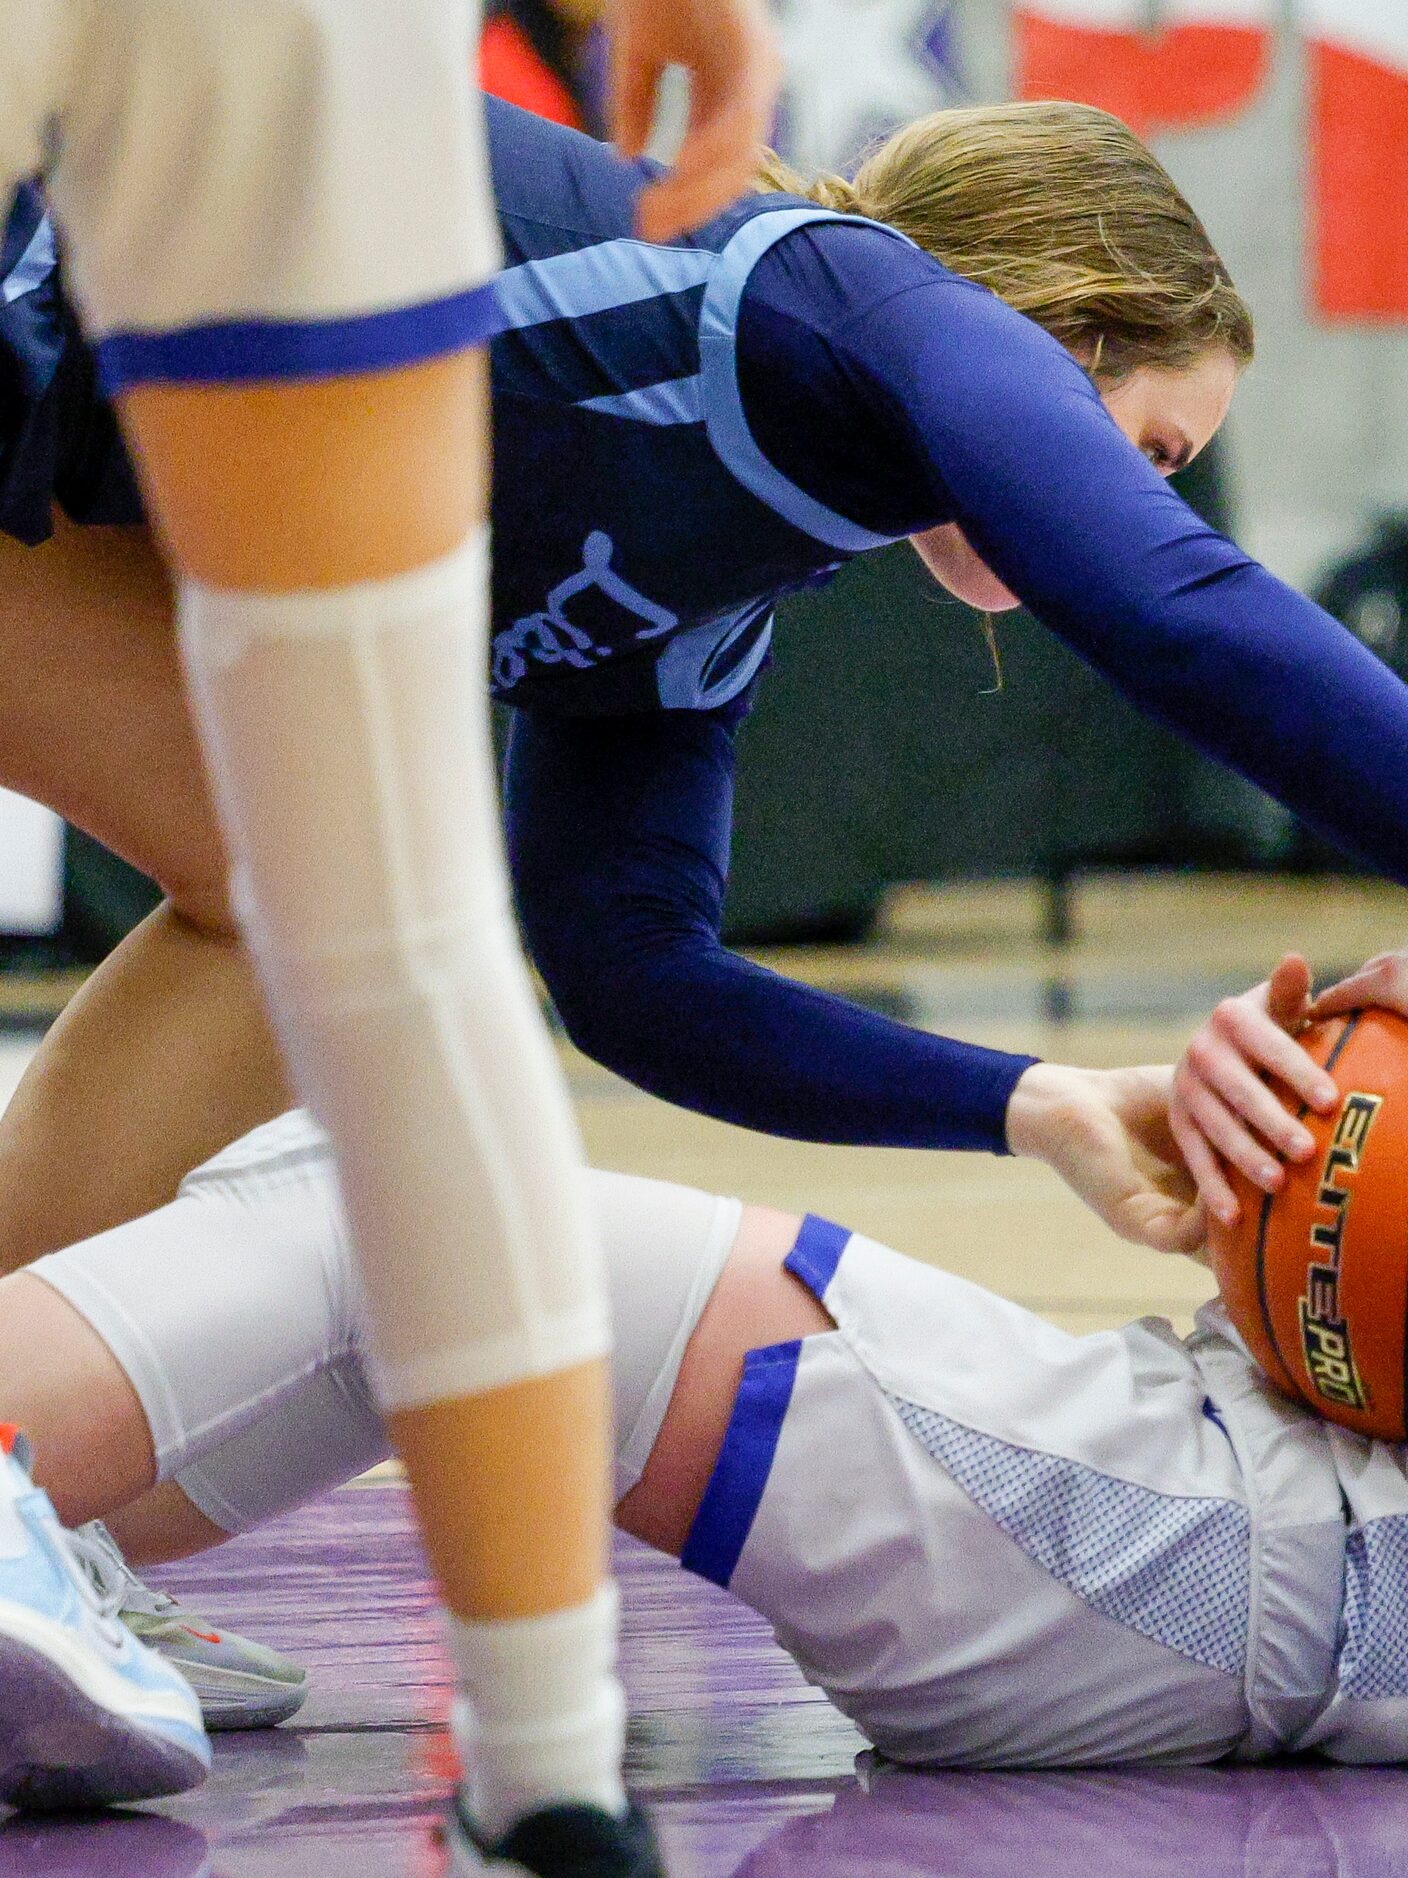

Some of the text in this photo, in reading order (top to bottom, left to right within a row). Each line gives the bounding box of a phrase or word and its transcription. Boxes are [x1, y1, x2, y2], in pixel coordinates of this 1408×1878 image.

[491, 529, 679, 689] Libe
[1303, 1092, 1384, 1410] ELITE PRO
